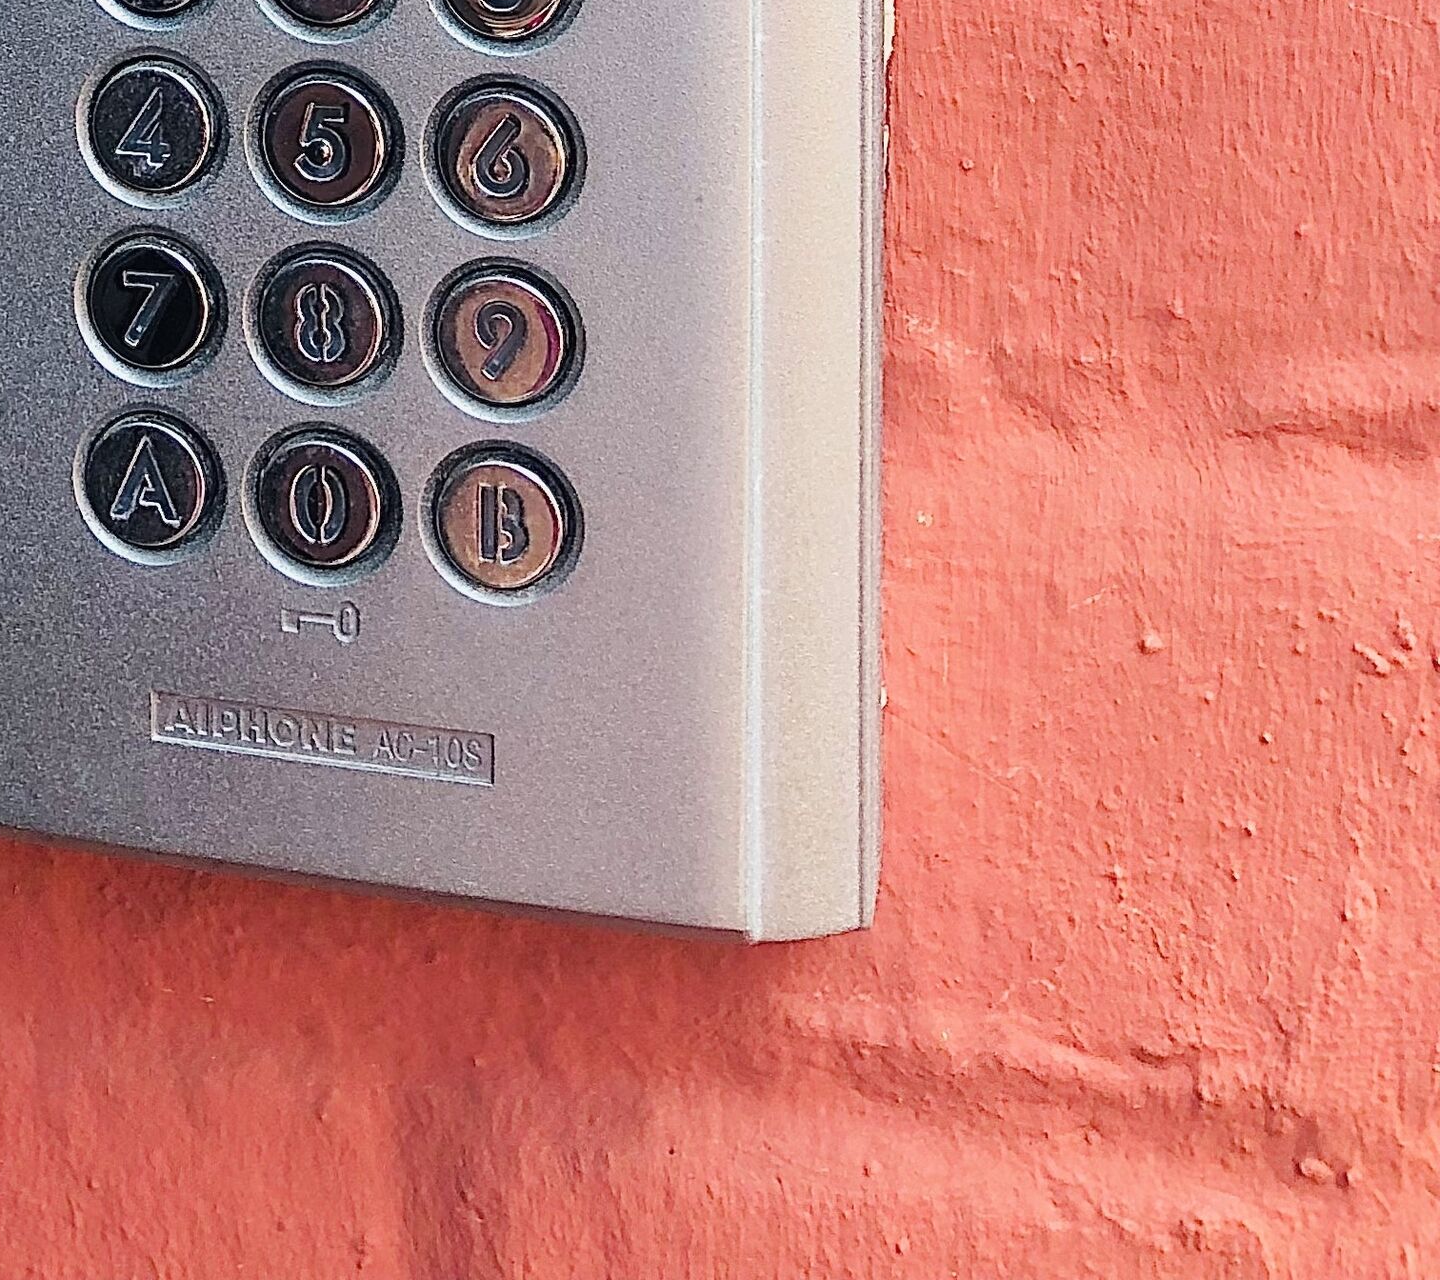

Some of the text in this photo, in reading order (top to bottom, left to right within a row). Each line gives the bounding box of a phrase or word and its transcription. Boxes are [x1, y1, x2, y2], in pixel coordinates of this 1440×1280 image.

[115, 85, 529, 198] 4 5 6
[122, 269, 528, 382] 7 8 9
[109, 435, 530, 565] A 0 B
[163, 701, 483, 772] AIPHONE AC-10S
